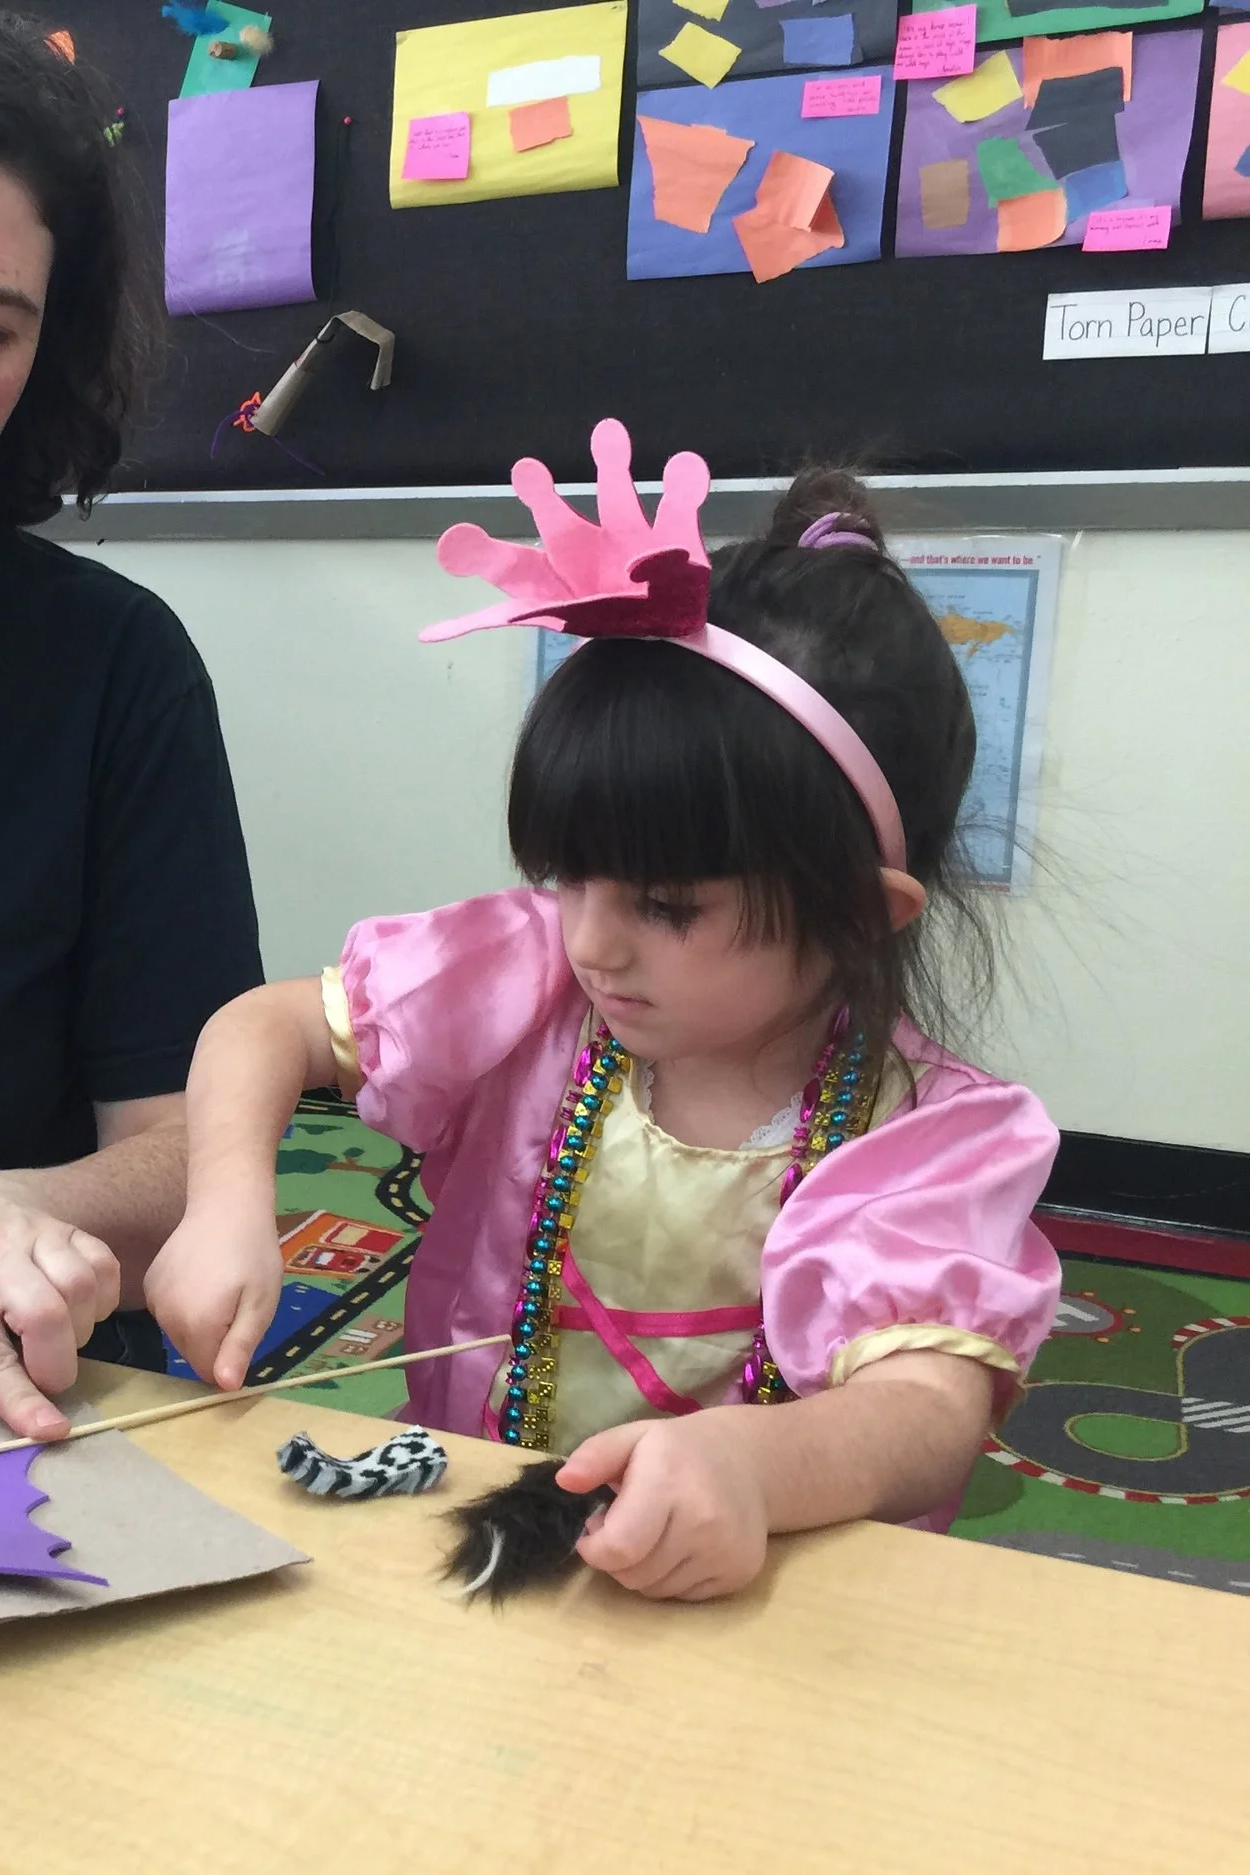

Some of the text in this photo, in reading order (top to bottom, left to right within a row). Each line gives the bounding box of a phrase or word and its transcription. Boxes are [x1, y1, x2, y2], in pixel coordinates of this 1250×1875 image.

[1050, 294, 1250, 348] Torn Paper C
[909, 554, 925, 565] and
[926, 554, 949, 565] that's
[950, 554, 976, 565] where
[977, 556, 989, 565] we
[991, 556, 1011, 565] want
[1012, 556, 1021, 565] to
